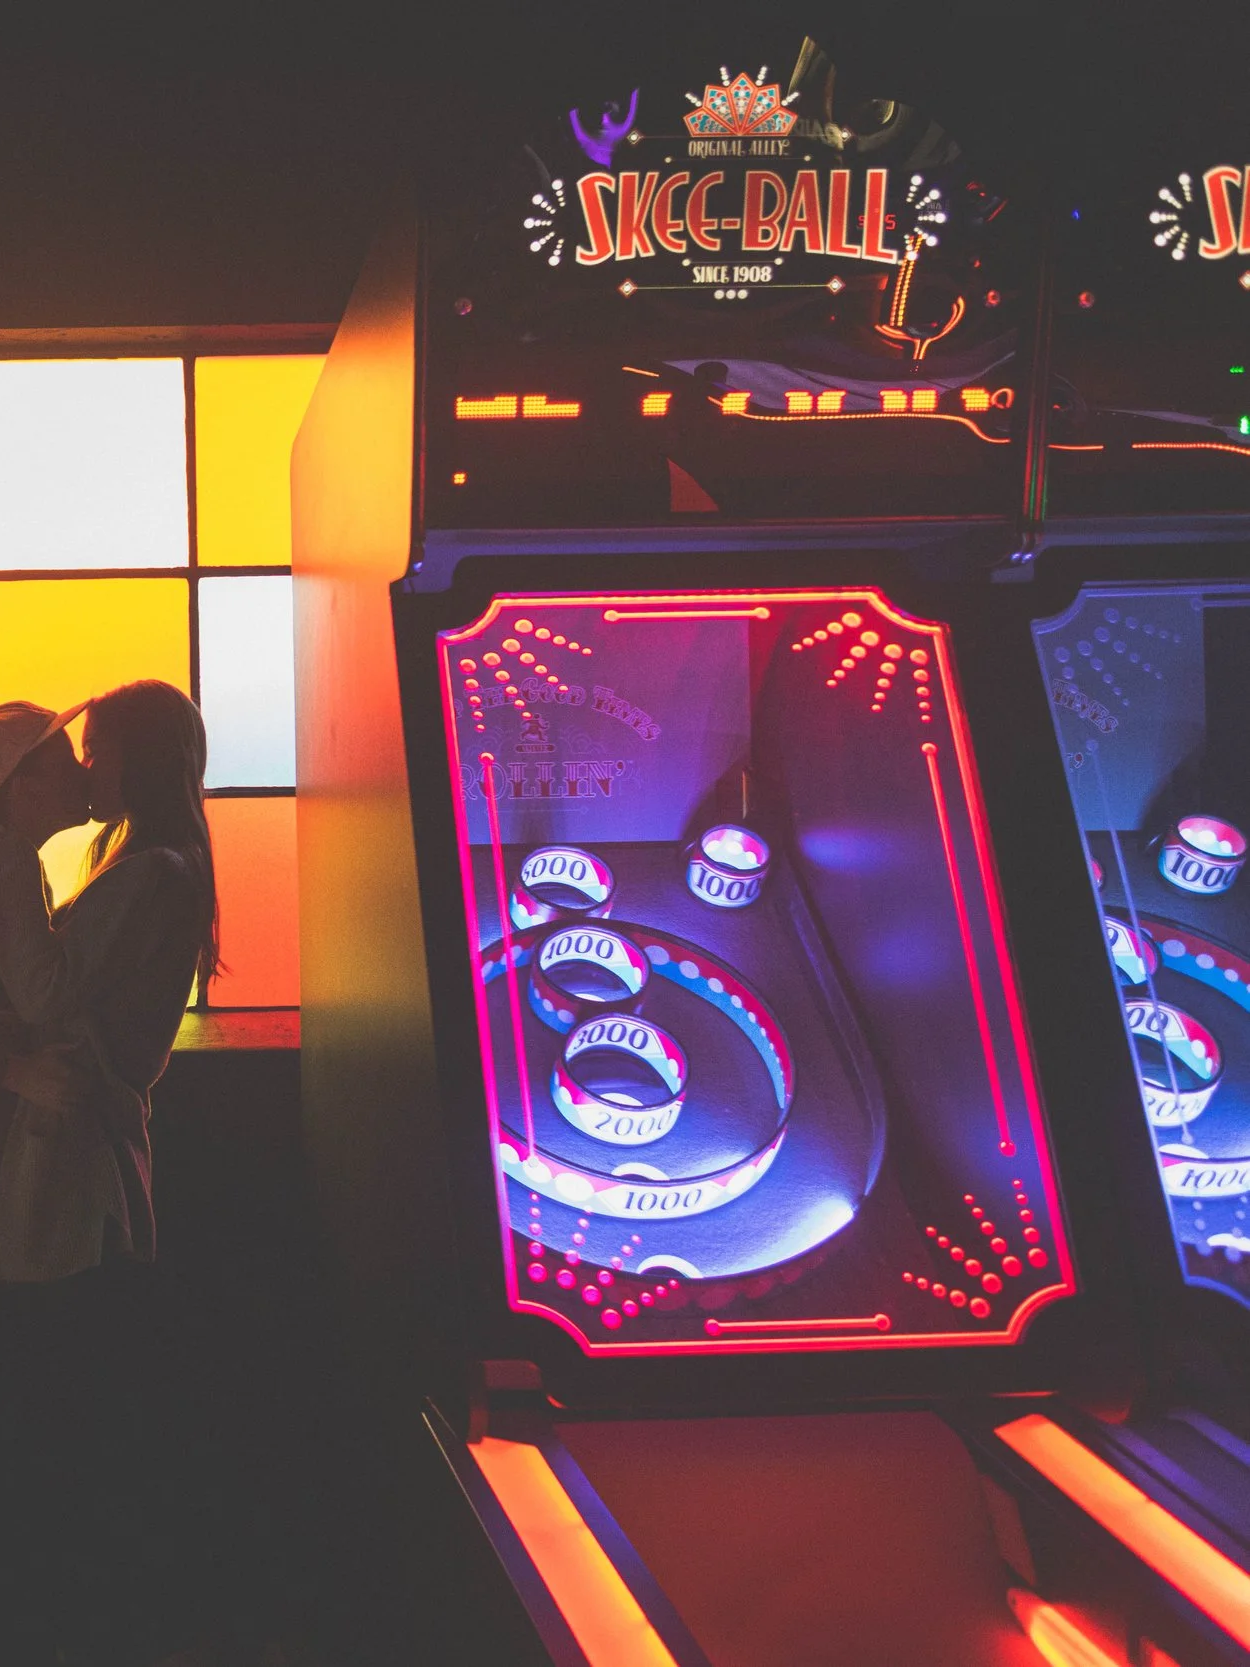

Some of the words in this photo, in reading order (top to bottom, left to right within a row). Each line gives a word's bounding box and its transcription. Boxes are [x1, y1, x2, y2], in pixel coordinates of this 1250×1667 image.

[688, 139, 745, 158] ORIGINAL
[575, 168, 899, 265] SKEE-BALL
[693, 266, 729, 284] SINCE
[733, 265, 772, 283] 1908
[573, 1023, 649, 1051] 3000
[594, 1109, 674, 1136] 2000
[624, 1189, 702, 1211] 1000
